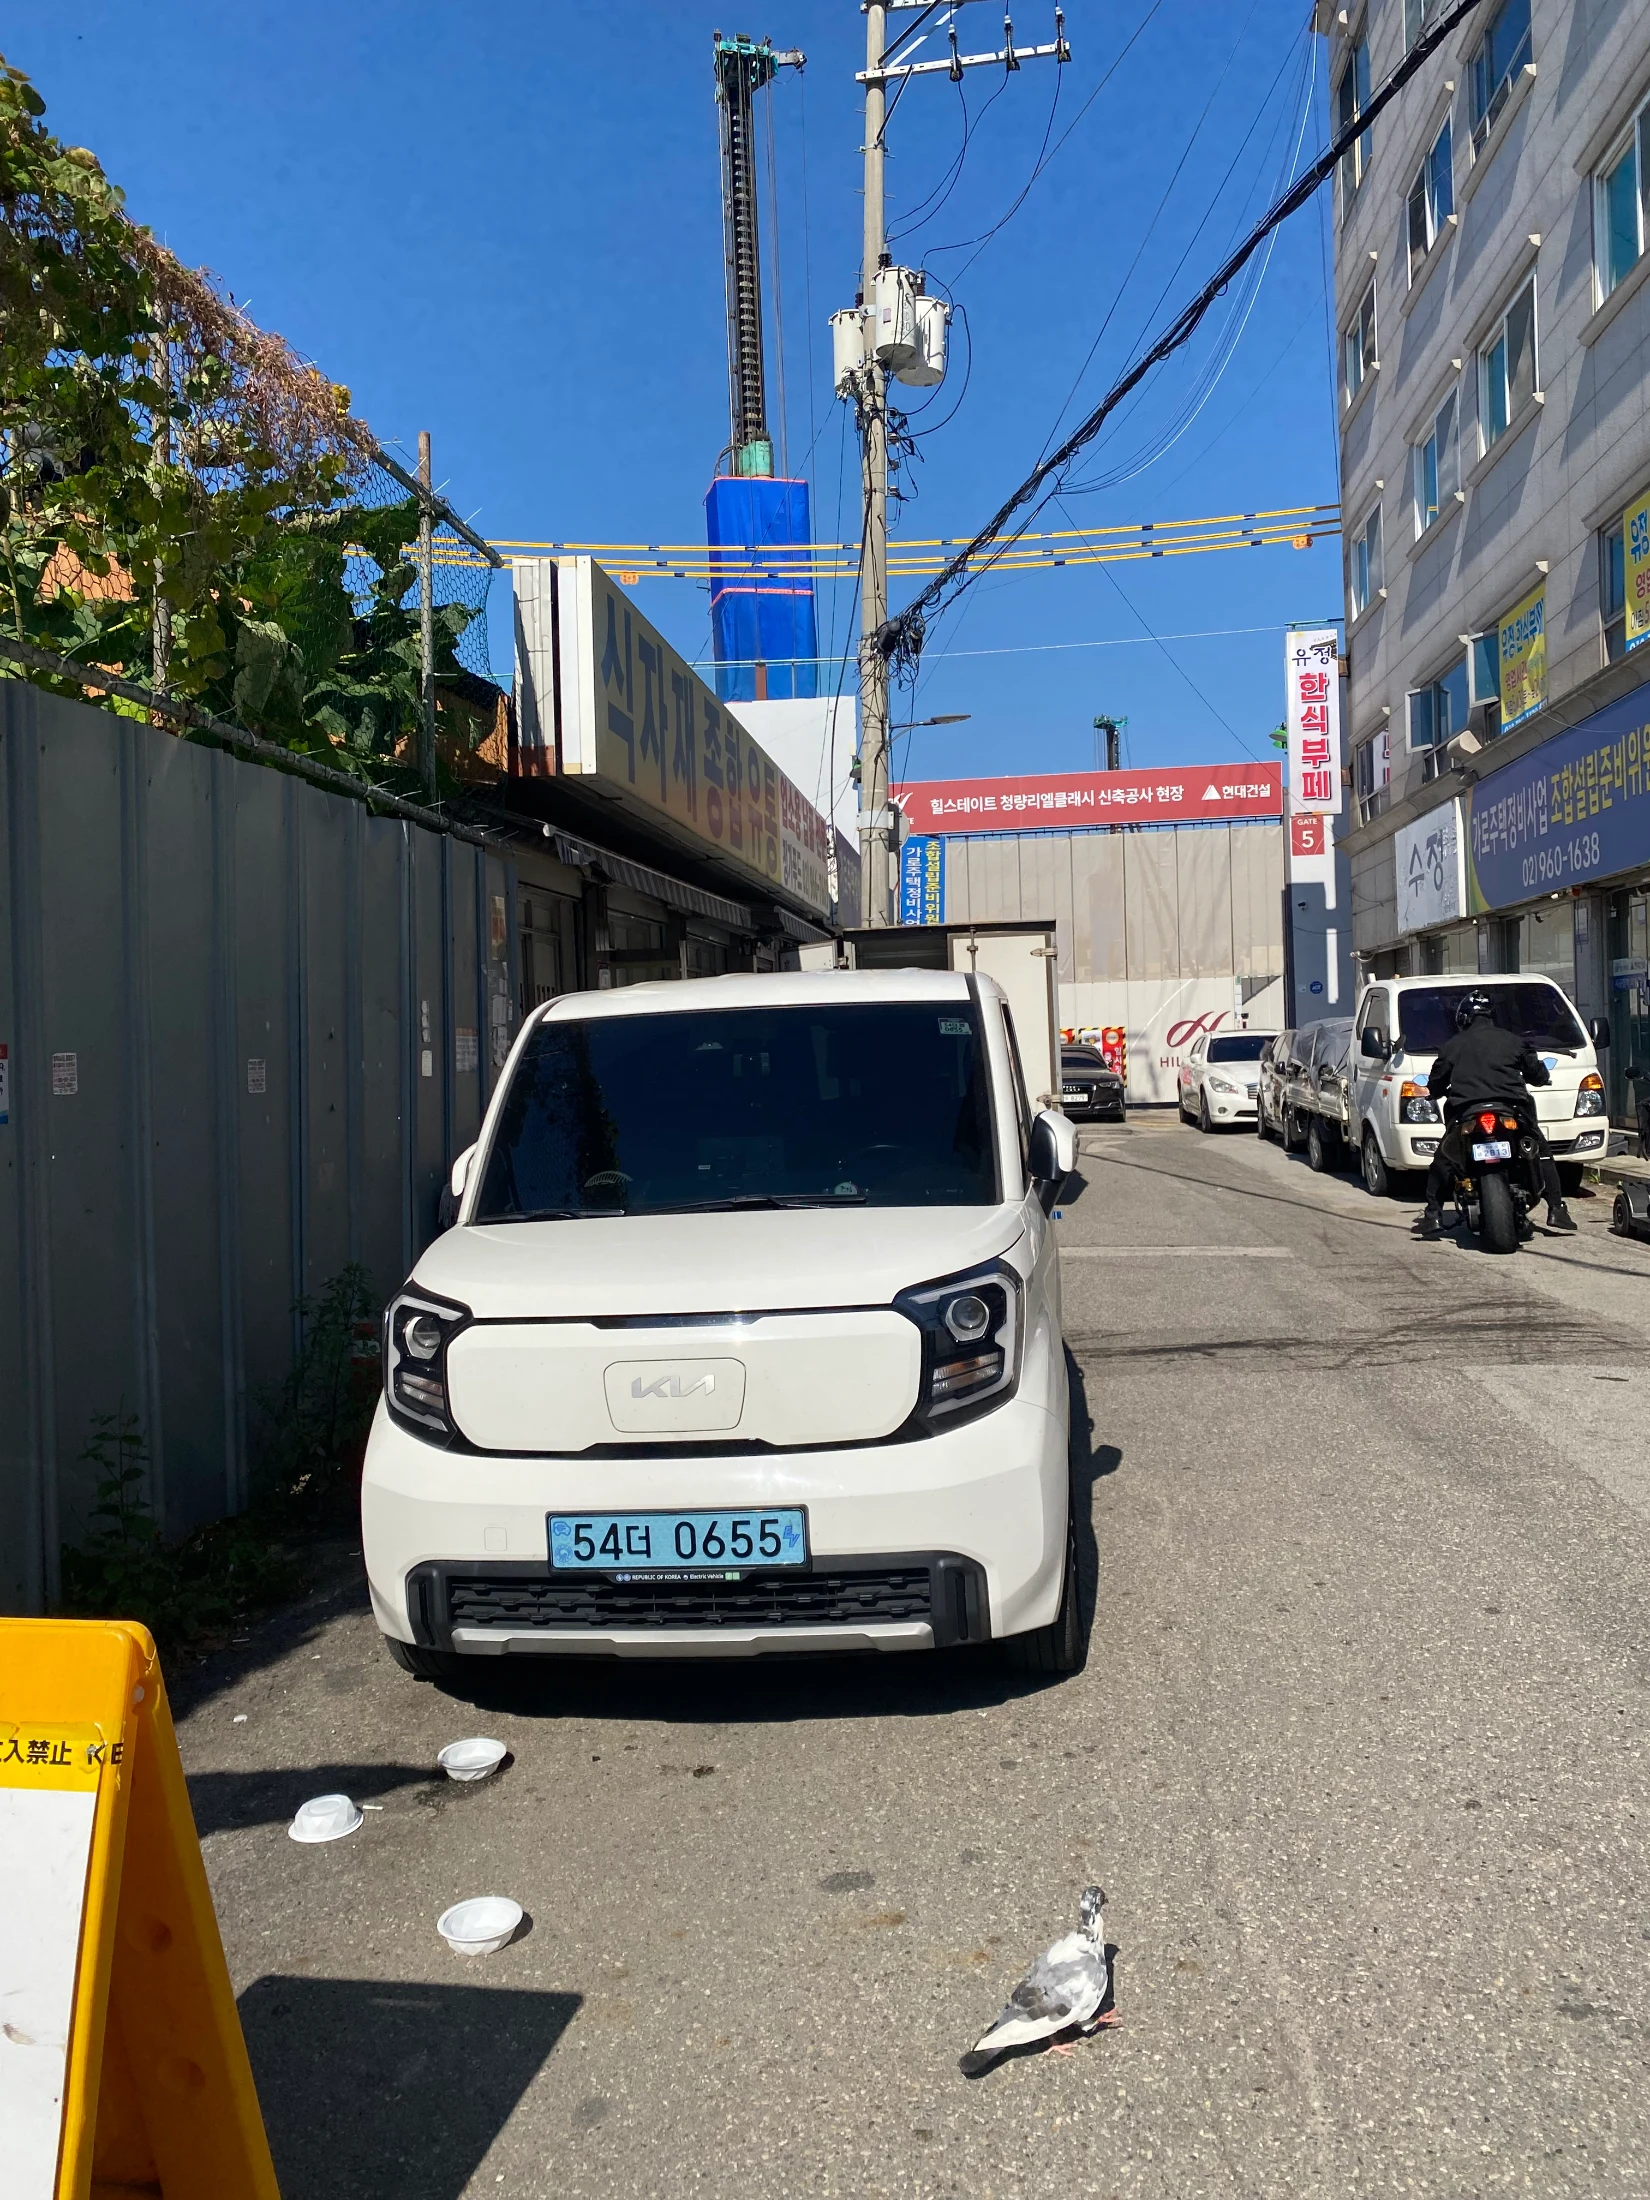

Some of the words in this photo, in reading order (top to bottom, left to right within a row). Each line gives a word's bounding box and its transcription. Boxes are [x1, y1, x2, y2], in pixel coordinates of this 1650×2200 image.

[1292, 647, 1330, 667] 유정
[601, 592, 697, 823] 식자재
[703, 696, 743, 852] 종합
[747, 746, 778, 876] 유통
[1299, 672, 1331, 801] 한식부페
[930, 796, 997, 816] 힐스테이트
[1000, 789, 1095, 811] 청량리엘클래시
[1098, 786, 1153, 806] 신축공사
[1156, 785, 1184, 803] 현장
[1222, 783, 1271, 800] 현대건설
[1297, 818, 1318, 826] GATE
[1472, 775, 1548, 863] 가로주택정비사업
[1301, 830, 1315, 849] 5
[1409, 829, 1444, 898] 수정
[1522, 832, 1600, 888] 02)960-1638
[631, 1374, 716, 1399] KIA
[573, 1522, 651, 1561] 54더
[674, 1518, 782, 1560] 0655
[783, 1525, 800, 1548] EV
[631, 1573, 656, 1581] REPUBLIC
[707, 1572, 724, 1580] Vehicle
